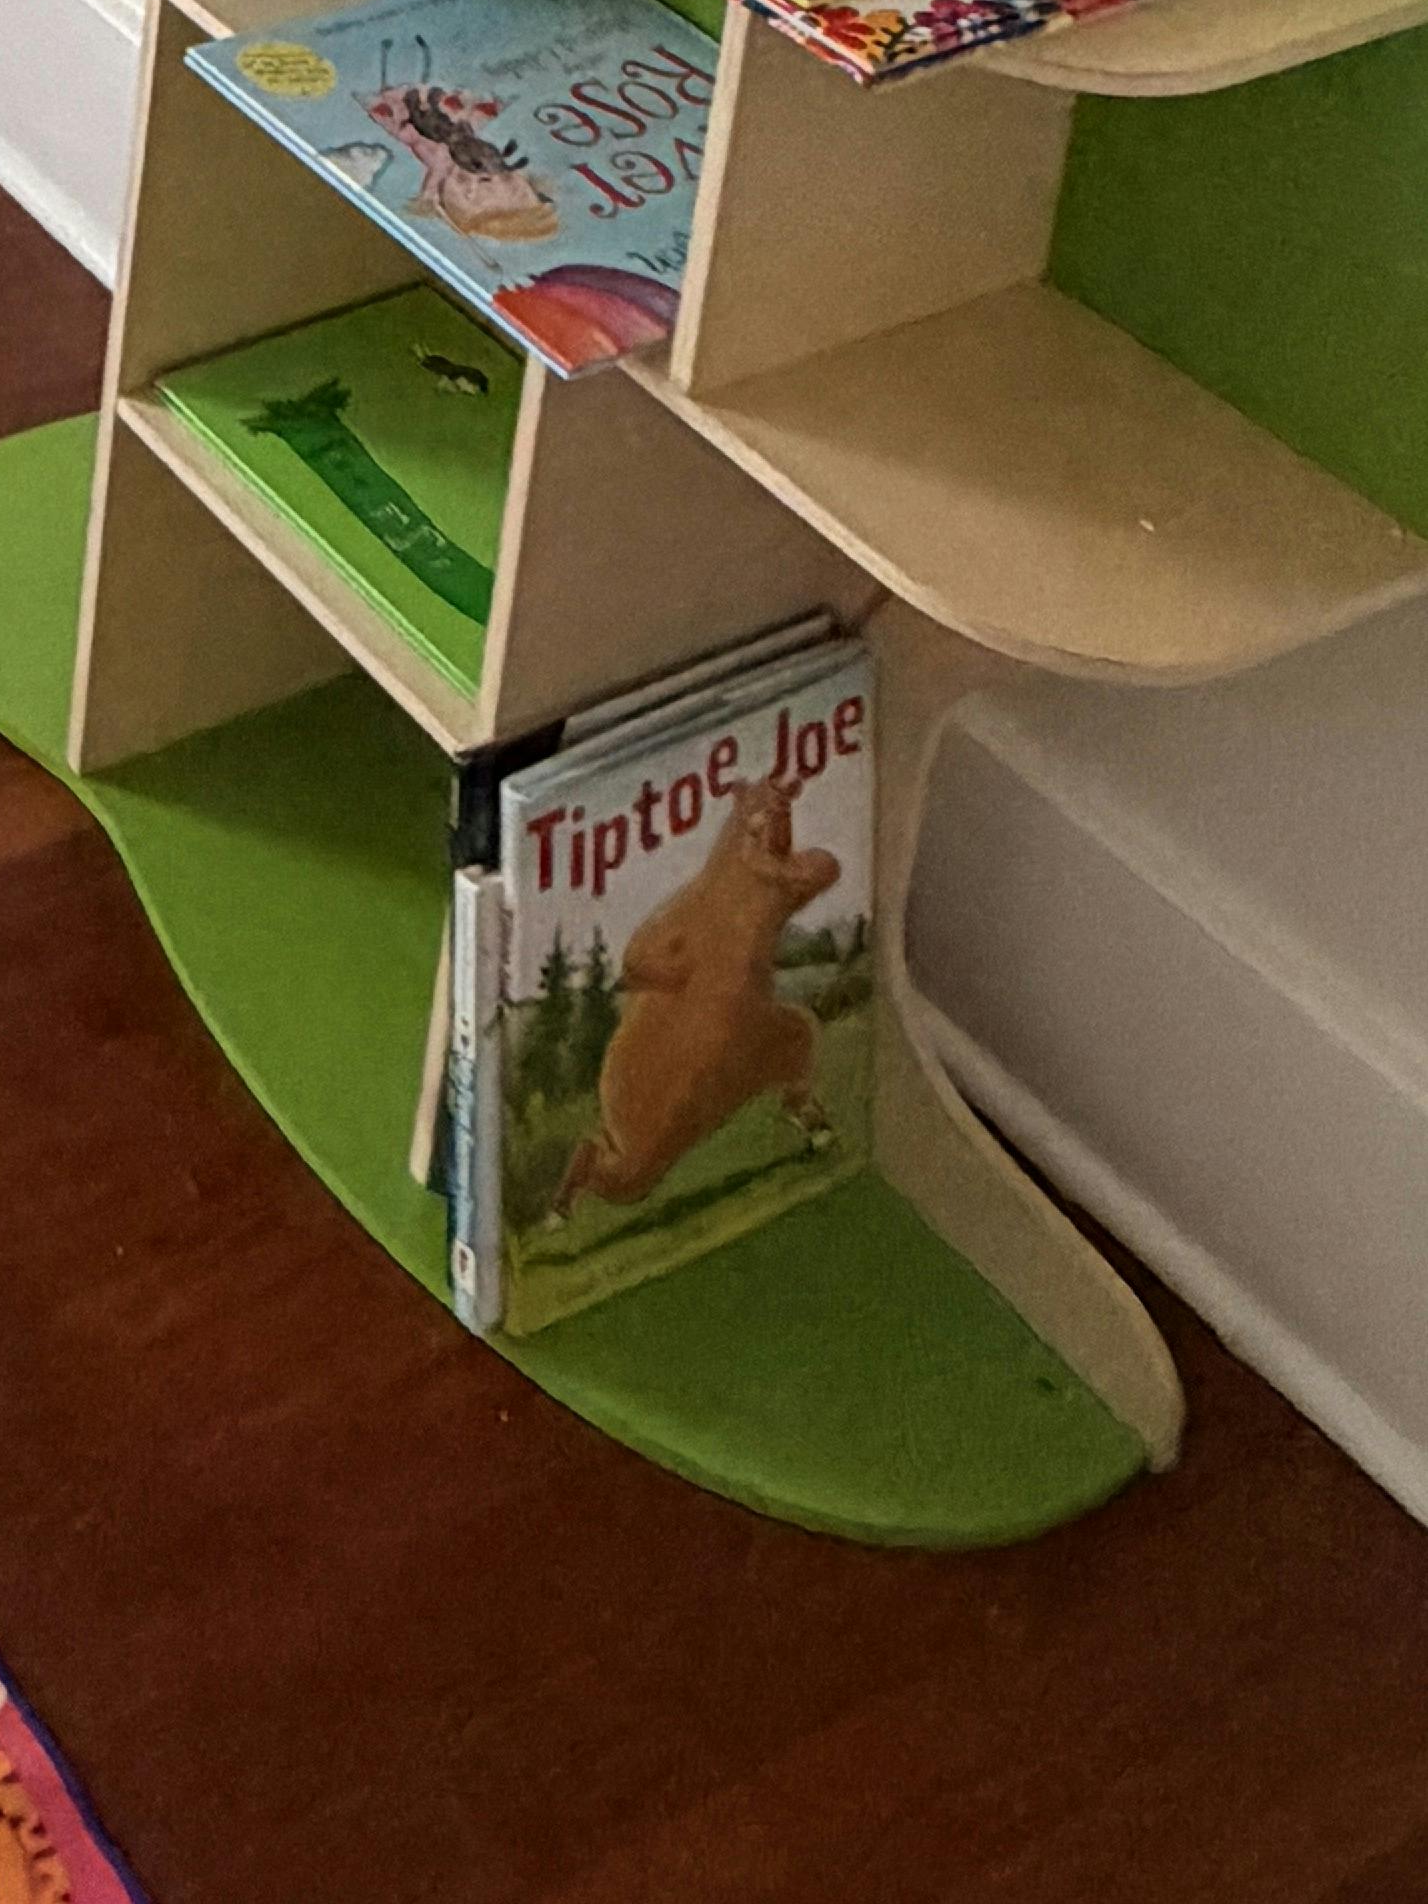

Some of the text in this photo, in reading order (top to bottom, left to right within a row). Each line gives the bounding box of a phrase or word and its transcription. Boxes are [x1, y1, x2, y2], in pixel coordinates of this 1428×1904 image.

[536, 45, 715, 146] Rose
[574, 131, 705, 219] ver
[528, 694, 865, 897] Tiptoe Joe
